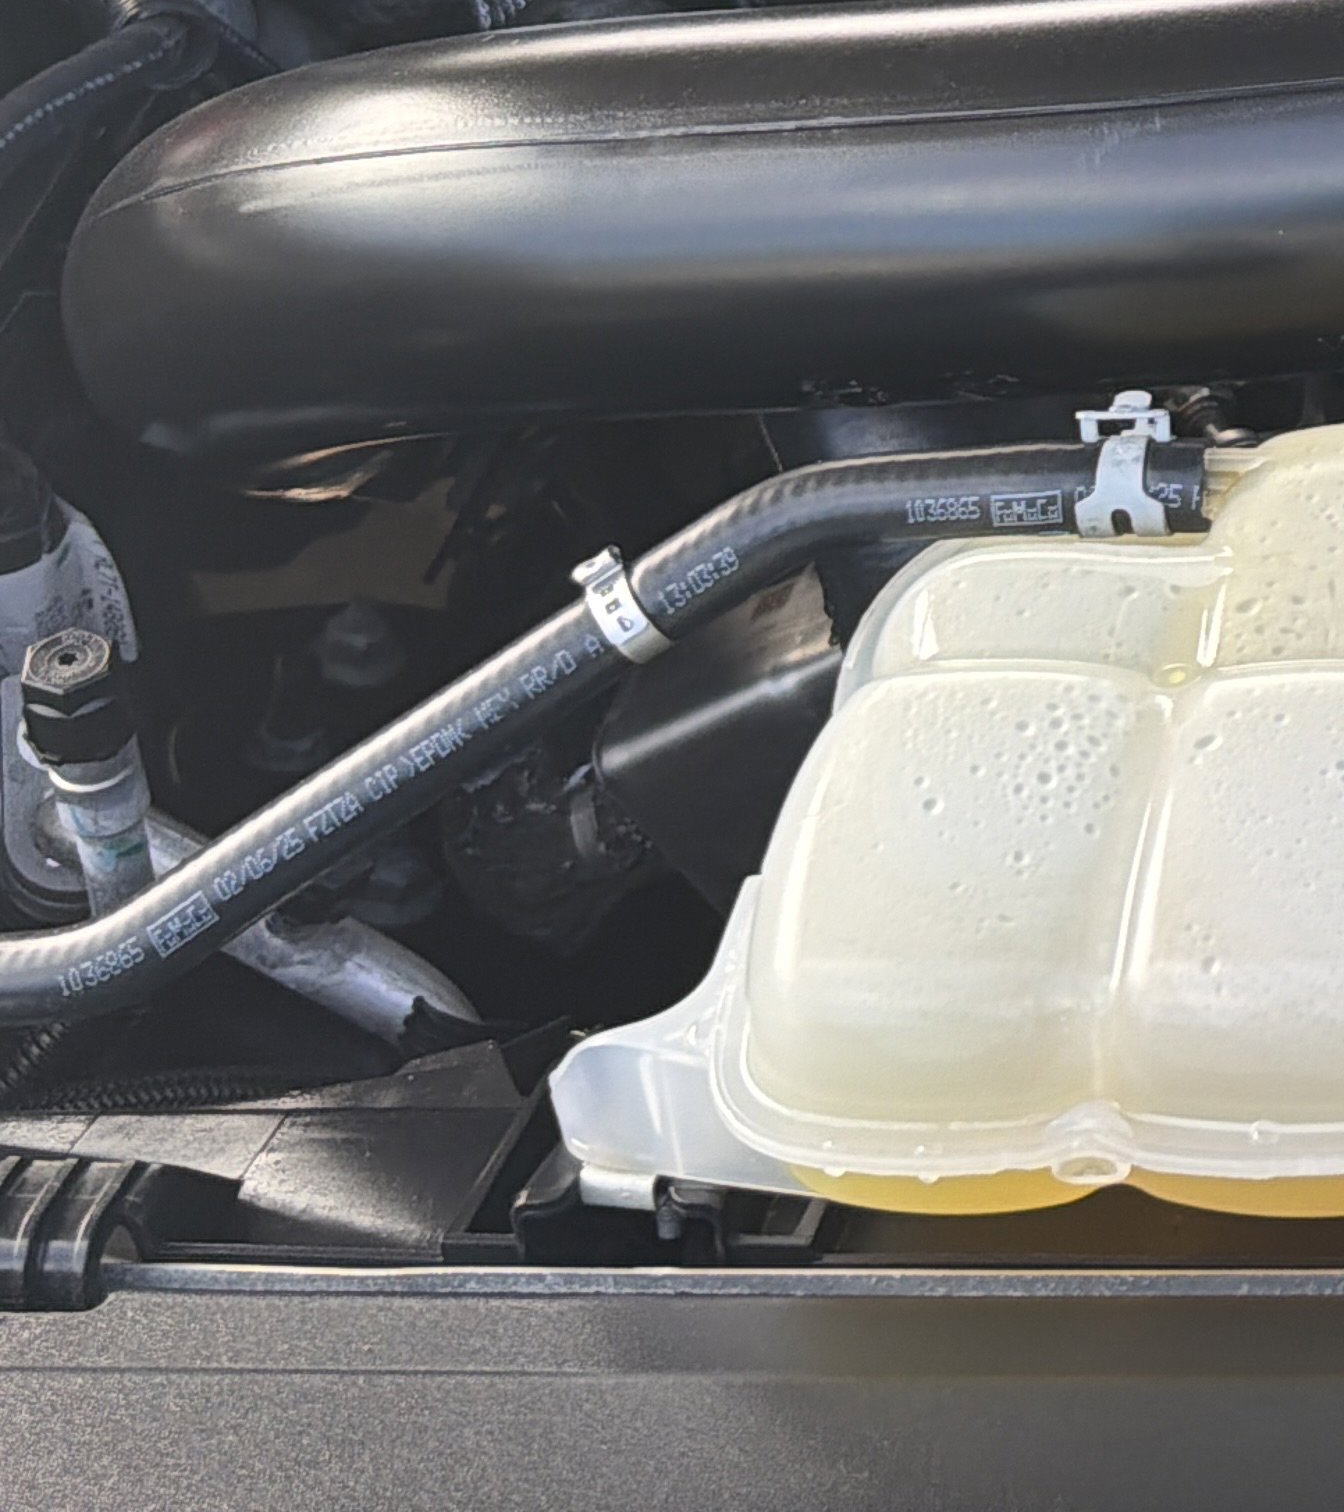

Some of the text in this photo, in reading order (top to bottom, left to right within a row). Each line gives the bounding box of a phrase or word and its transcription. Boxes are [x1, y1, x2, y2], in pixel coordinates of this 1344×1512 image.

[905, 495, 981, 524] 1036865
[57, 935, 146, 998] 1036865
[212, 826, 306, 901] 02/06/25
[658, 545, 741, 615] 13:03:39
